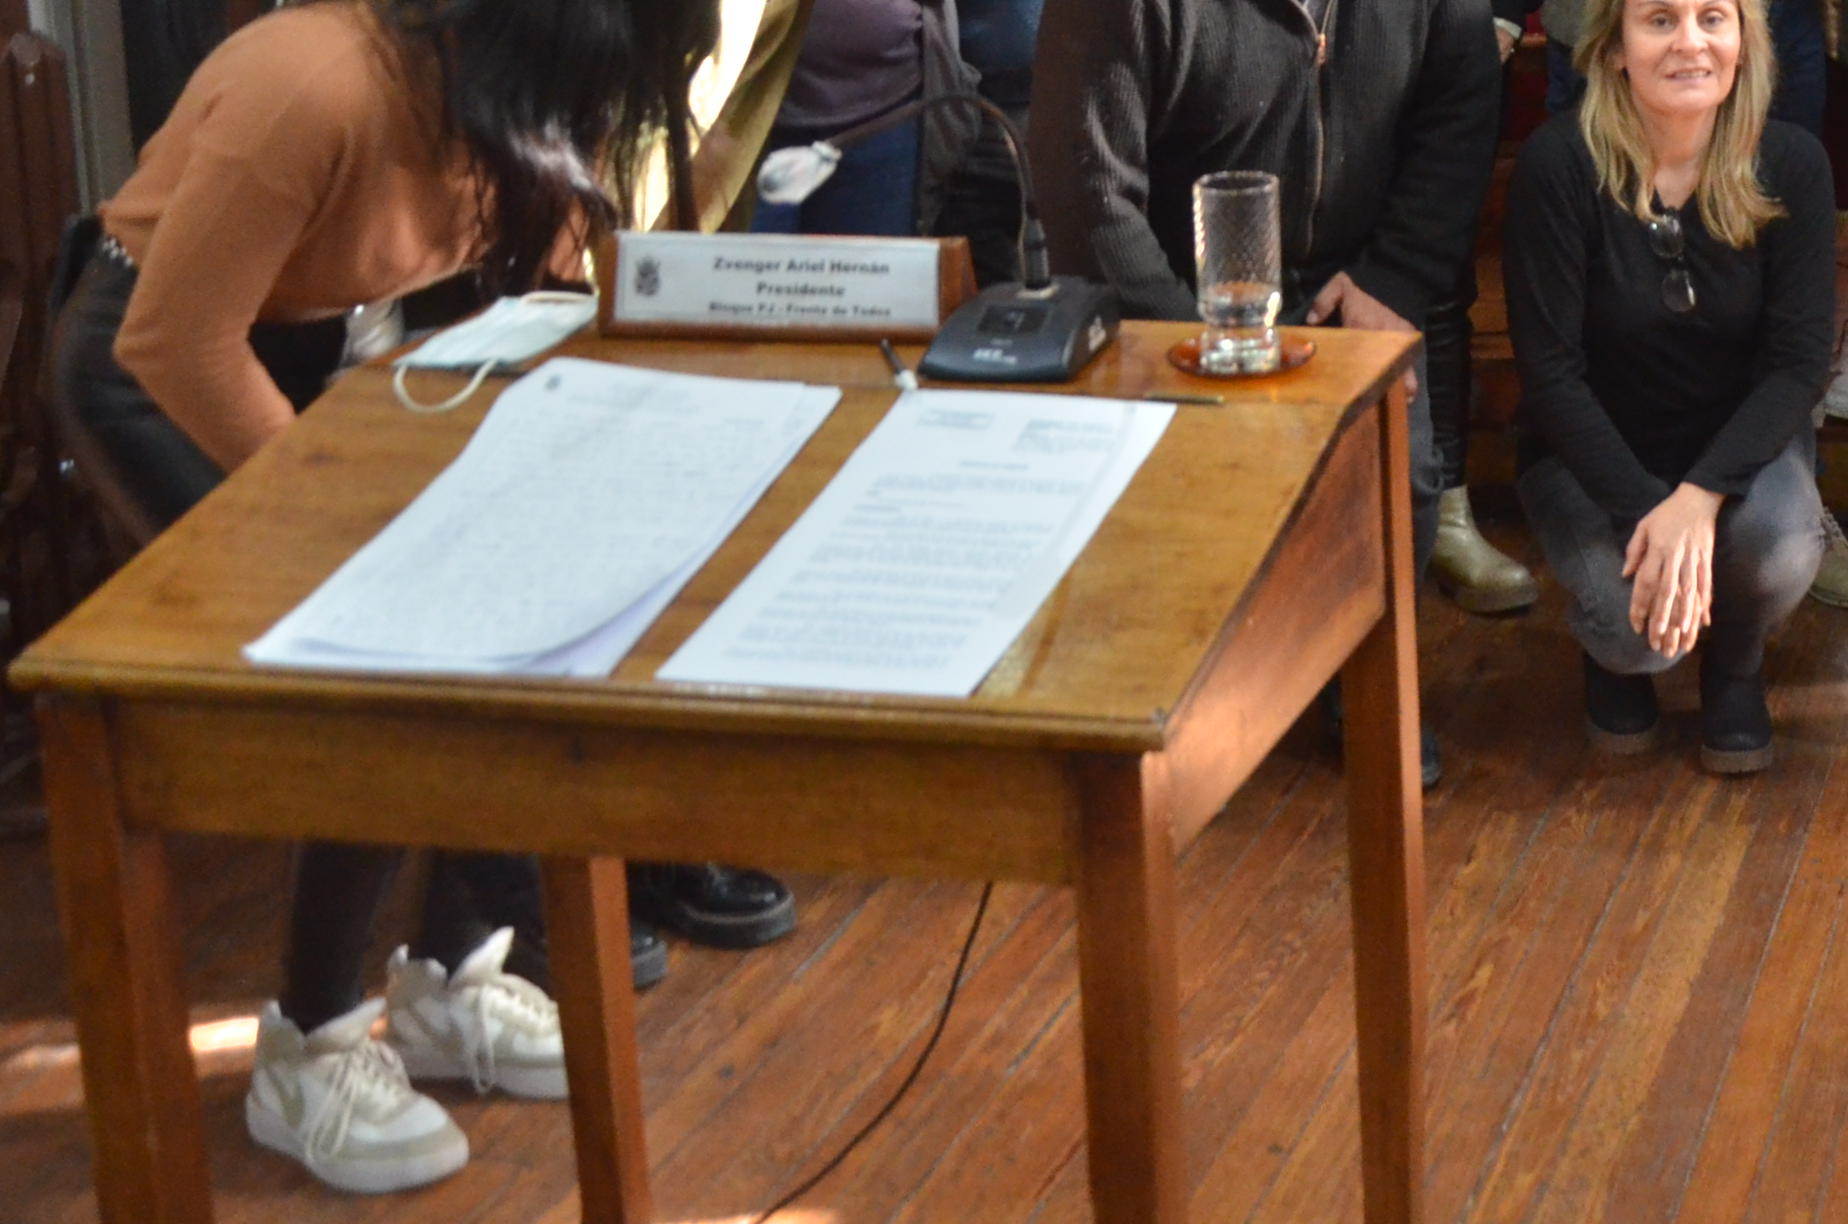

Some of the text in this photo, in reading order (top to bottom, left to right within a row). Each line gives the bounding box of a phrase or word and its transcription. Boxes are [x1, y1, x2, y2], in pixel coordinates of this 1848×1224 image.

[787, 259, 825, 273] Ariel
[831, 259, 889, 273] Hernán
[757, 281, 845, 296] Presidente
